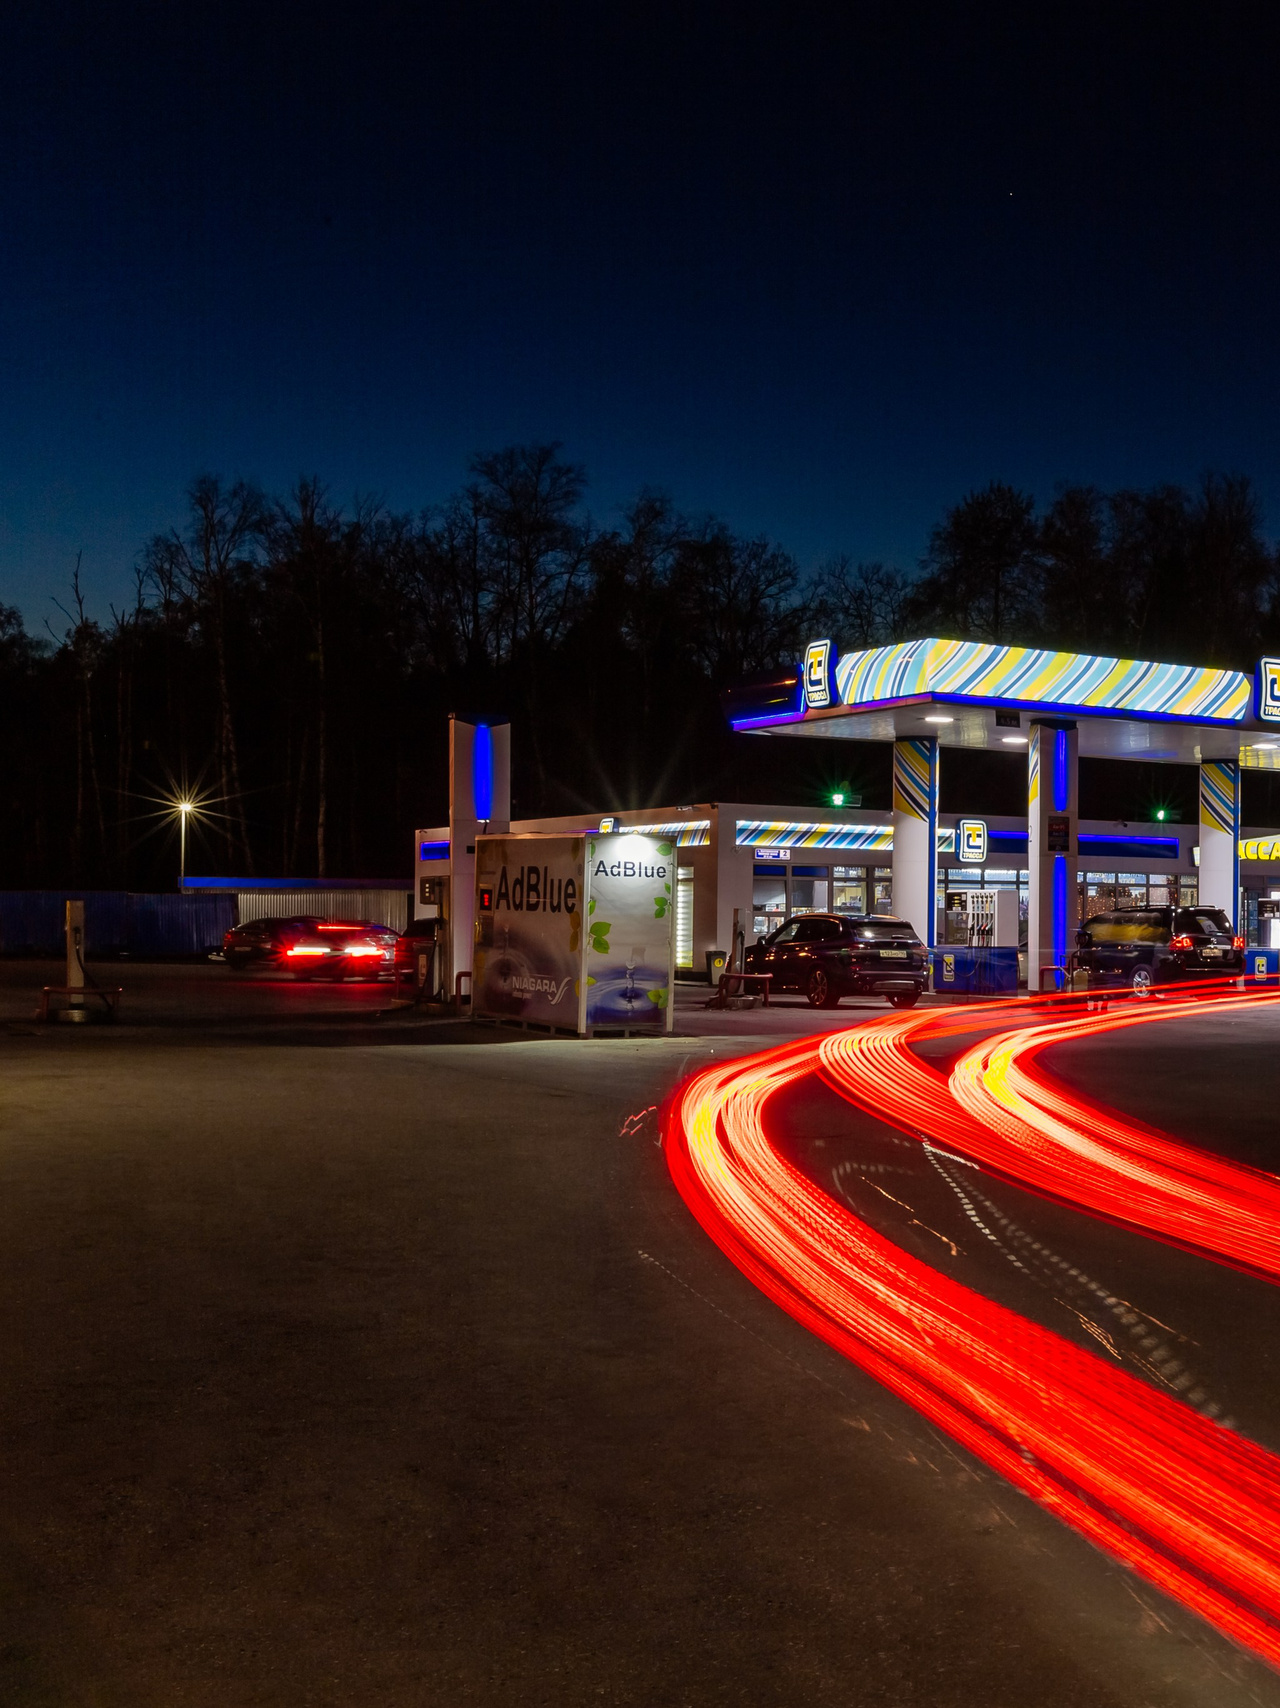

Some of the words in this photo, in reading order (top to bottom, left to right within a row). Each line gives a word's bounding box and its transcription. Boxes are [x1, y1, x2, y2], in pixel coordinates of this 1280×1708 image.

[594, 860, 667, 879] AdBlue
[495, 866, 577, 914] AdBlue
[512, 976, 557, 994] NIAGARA
